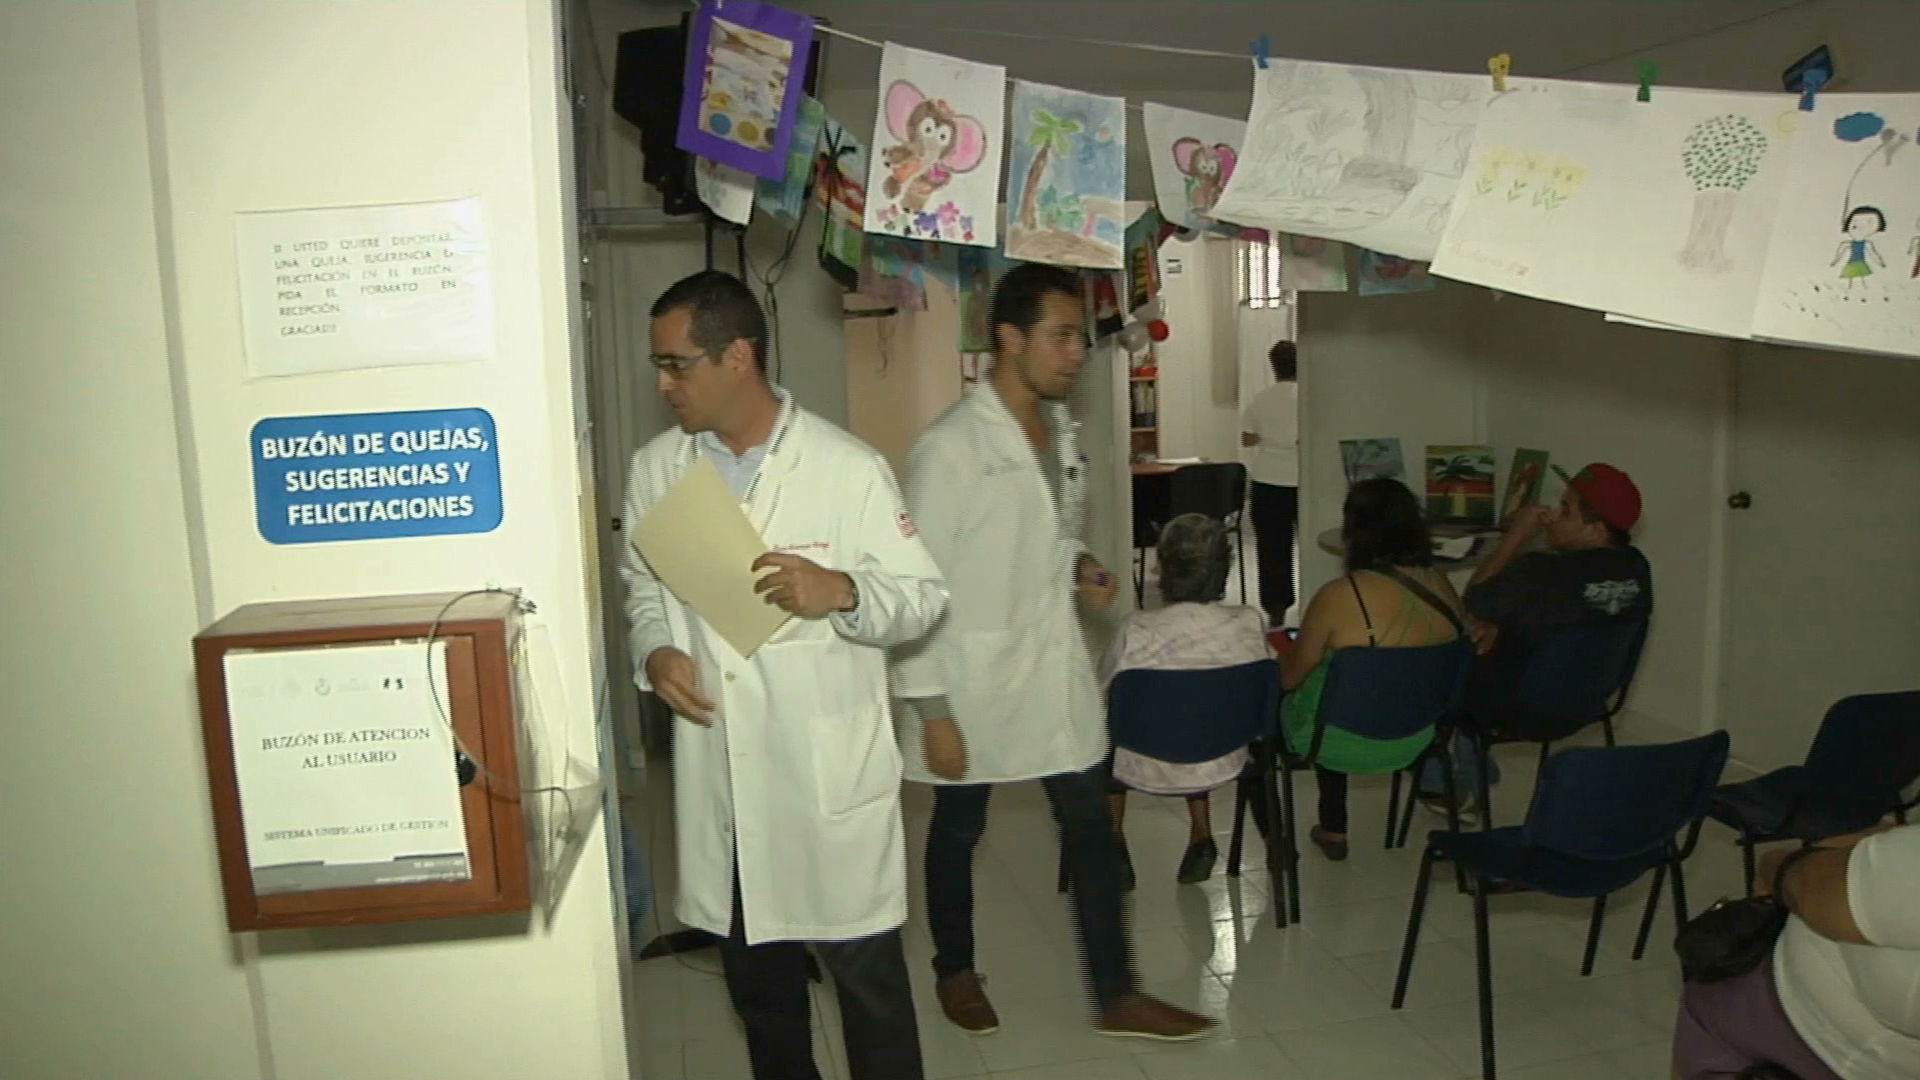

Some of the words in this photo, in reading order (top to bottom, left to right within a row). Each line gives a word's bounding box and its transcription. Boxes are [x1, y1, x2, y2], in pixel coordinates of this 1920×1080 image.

[293, 240, 329, 252] USTED
[340, 236, 380, 250] QUIERE
[274, 259, 300, 270] UNA
[364, 250, 431, 264] SUGERENCIA
[325, 288, 337, 298] EL
[360, 282, 419, 295] FORMATO
[441, 280, 456, 289] EN
[279, 302, 341, 316] RECEPCIÓN
[260, 430, 348, 460] BUZÓN
[351, 432, 386, 455] DE
[389, 427, 490, 455] QUEJAS,
[284, 462, 450, 493] SUGERENCIAS
[453, 461, 471, 483] Y
[287, 495, 475, 526] FELICITACIONES
[262, 734, 320, 750] BUZÓN
[323, 732, 347, 745] DE
[348, 727, 431, 743] ATENCION
[302, 756, 324, 769] AL
[326, 750, 398, 766] USUARIO
[264, 829, 314, 841] SISTEMA
[316, 824, 379, 836] UNIFICADO
